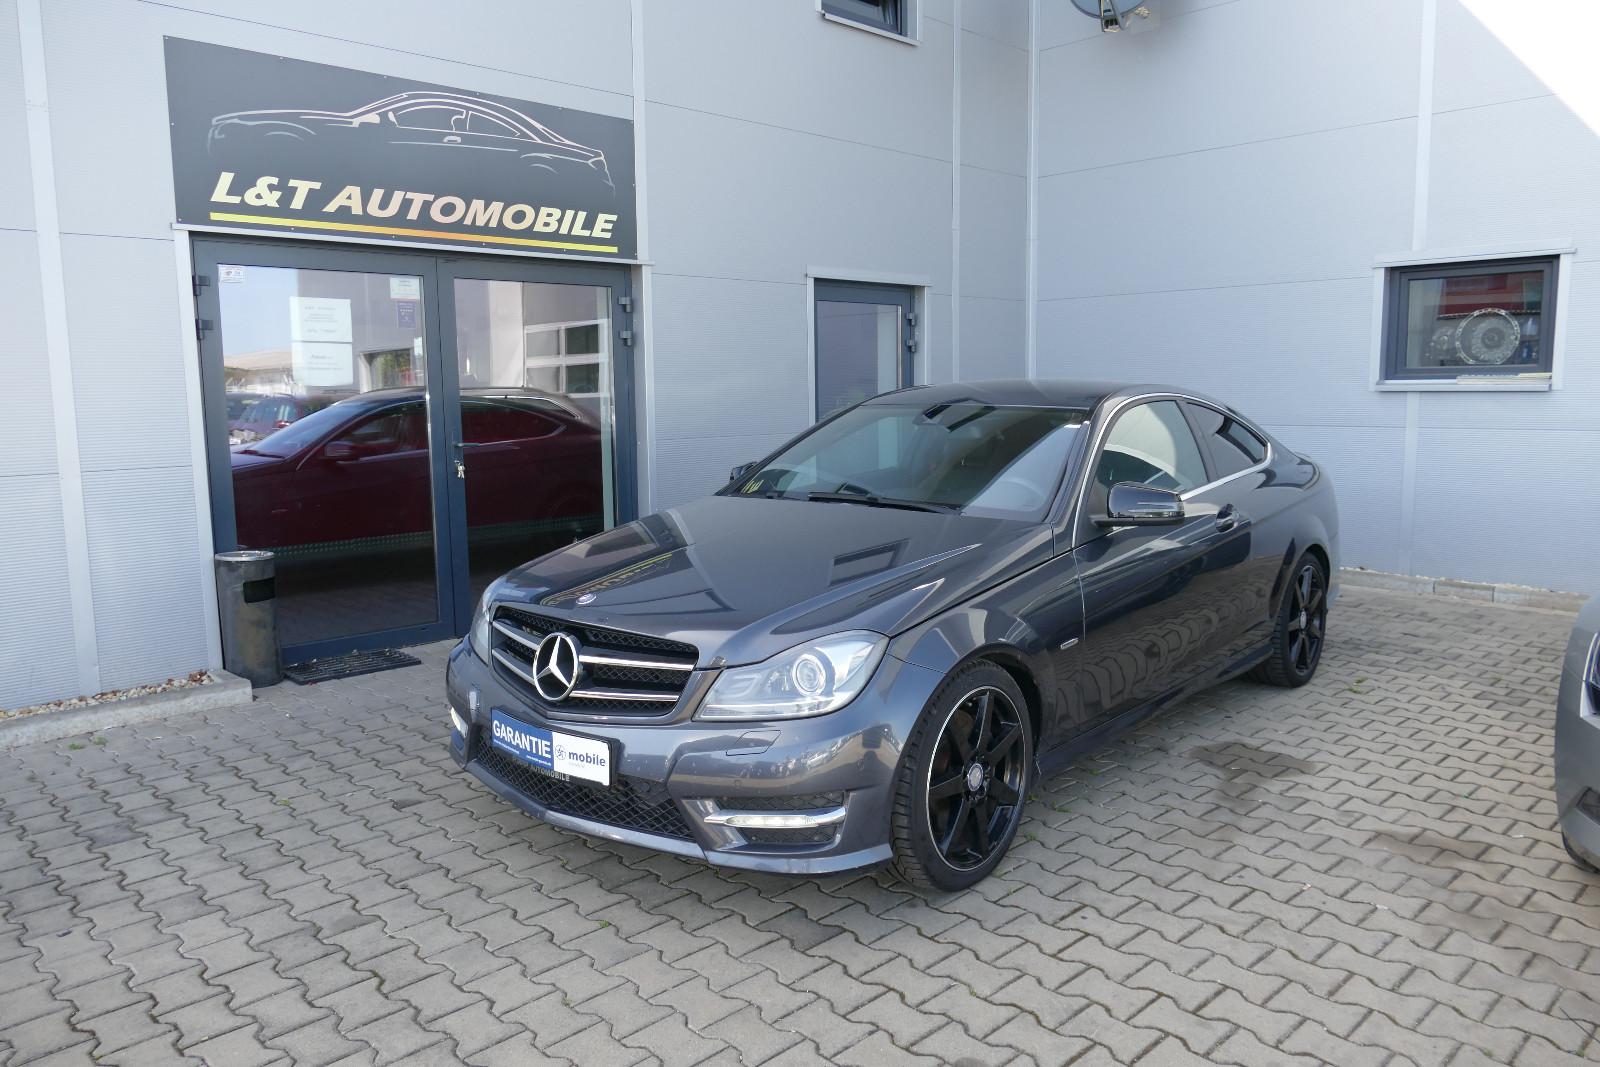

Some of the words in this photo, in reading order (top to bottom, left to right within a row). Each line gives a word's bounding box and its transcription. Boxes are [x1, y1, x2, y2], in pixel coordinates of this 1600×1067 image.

[211, 171, 322, 209] L&T
[322, 185, 617, 239] AUTOMOBILE
[493, 720, 551, 759] GARANTIE
[568, 751, 606, 767] mobile
